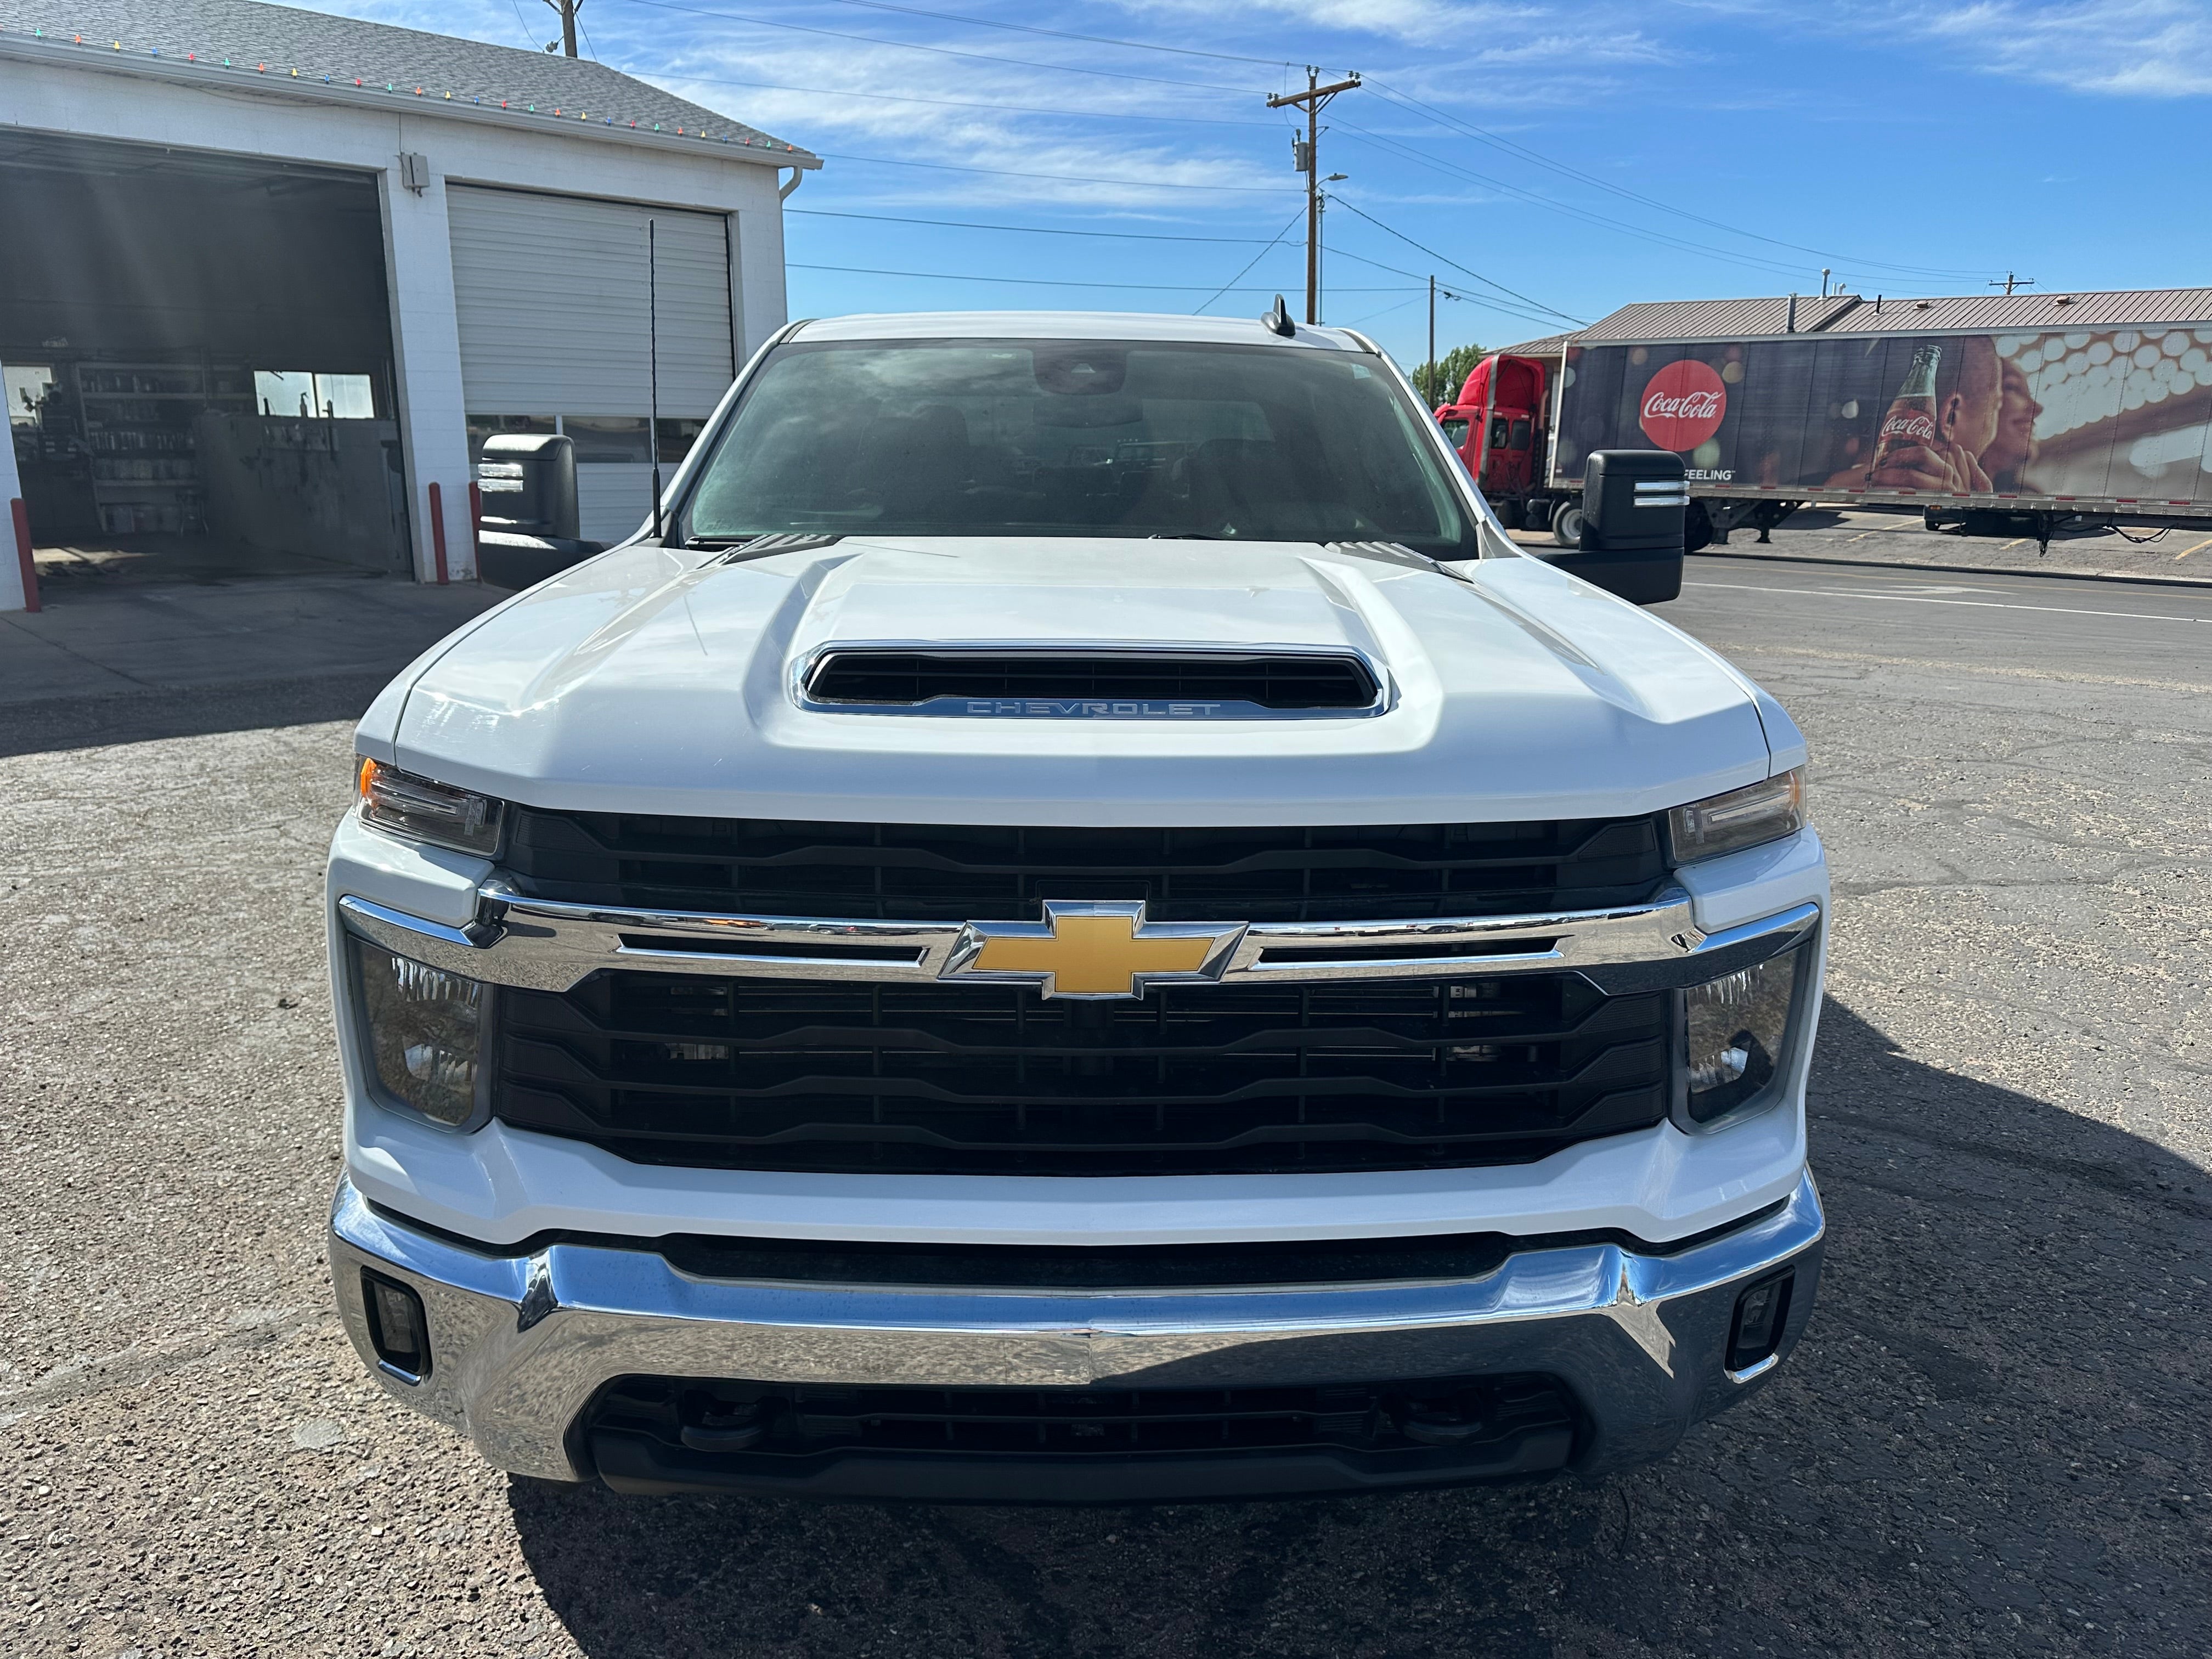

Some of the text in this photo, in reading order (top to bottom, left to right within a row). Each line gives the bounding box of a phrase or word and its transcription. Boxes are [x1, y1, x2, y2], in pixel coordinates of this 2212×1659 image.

[1644, 391, 1724, 419] Coca-Cola
[1881, 415, 1933, 439] Coca-Cola
[967, 701, 1221, 716] CHEVROLET
